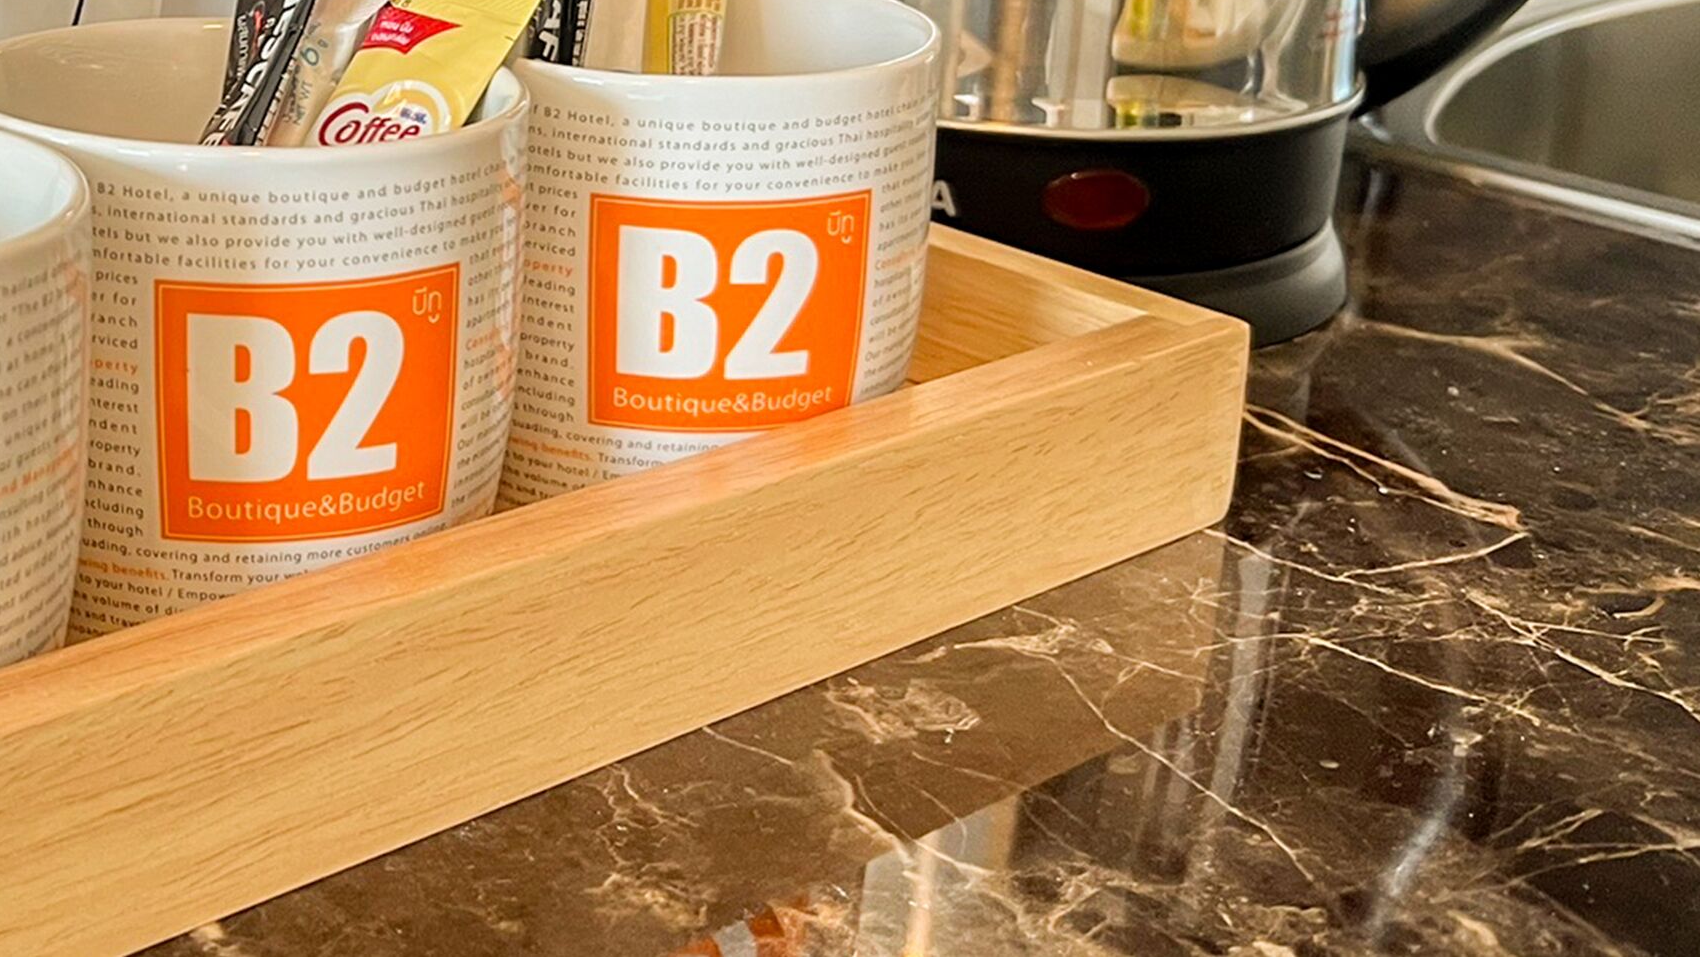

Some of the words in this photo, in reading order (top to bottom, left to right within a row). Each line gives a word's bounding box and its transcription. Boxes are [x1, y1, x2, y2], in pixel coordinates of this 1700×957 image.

[319, 101, 421, 148] Coffee
[568, 110, 614, 127] Hotel,
[637, 118, 695, 131] unique
[702, 120, 777, 133] boutique
[782, 118, 810, 130] and
[815, 112, 862, 127] budget
[552, 128, 652, 149] international
[658, 141, 736, 152] standards
[742, 141, 770, 152] and
[775, 137, 833, 153] gracious
[567, 150, 592, 163] but
[597, 154, 619, 166] we
[624, 156, 655, 169] also
[660, 160, 720, 172] provide
[726, 162, 754, 173] you
[759, 159, 790, 170] with
[796, 148, 881, 169] well-designed
[122, 185, 174, 202] Hotel,
[198, 190, 261, 205] unique
[268, 190, 350, 204] boutique
[357, 184, 387, 199] and
[393, 177, 445, 195] budget
[615, 174, 688, 190] facilities
[695, 179, 719, 191] for
[725, 181, 761, 192] your
[766, 172, 854, 190] convenience
[858, 169, 870, 180] to
[538, 185, 578, 199] prices
[108, 206, 216, 224] international
[222, 213, 307, 226] standards
[313, 211, 344, 224] and
[350, 204, 415, 224] gracious
[420, 199, 447, 212] Thai
[554, 204, 576, 218] for
[125, 230, 151, 243] but
[157, 234, 180, 245] we
[186, 234, 219, 247] also
[225, 236, 291, 249] provide
[296, 236, 327, 249] you
[333, 232, 368, 244] with
[373, 214, 466, 241] well-designed
[177, 254, 256, 270] facilities
[264, 257, 289, 270] for
[296, 257, 335, 270] your
[342, 245, 438, 267] convenience
[443, 240, 456, 251] to
[95, 271, 138, 285] prices
[523, 274, 576, 296] leading
[113, 291, 136, 305] for
[522, 294, 575, 314] interest
[616, 224, 820, 381] B2
[520, 332, 575, 352] property
[517, 367, 575, 387] enhance
[186, 309, 405, 484] B2
[612, 384, 833, 418] Boutique&Budget
[522, 402, 574, 423] through
[566, 431, 623, 449] covering
[627, 440, 652, 450] and
[556, 462, 589, 477] hotel
[187, 480, 426, 525] Boutique&Budget
[87, 518, 143, 538] through
[136, 547, 199, 564] covering
[203, 553, 230, 564] and
[235, 552, 302, 564] retaining
[306, 549, 343, 561] more
[94, 577, 123, 589] your
[128, 582, 163, 597] hotel
[171, 569, 243, 583] Transform
[247, 574, 279, 586] your
